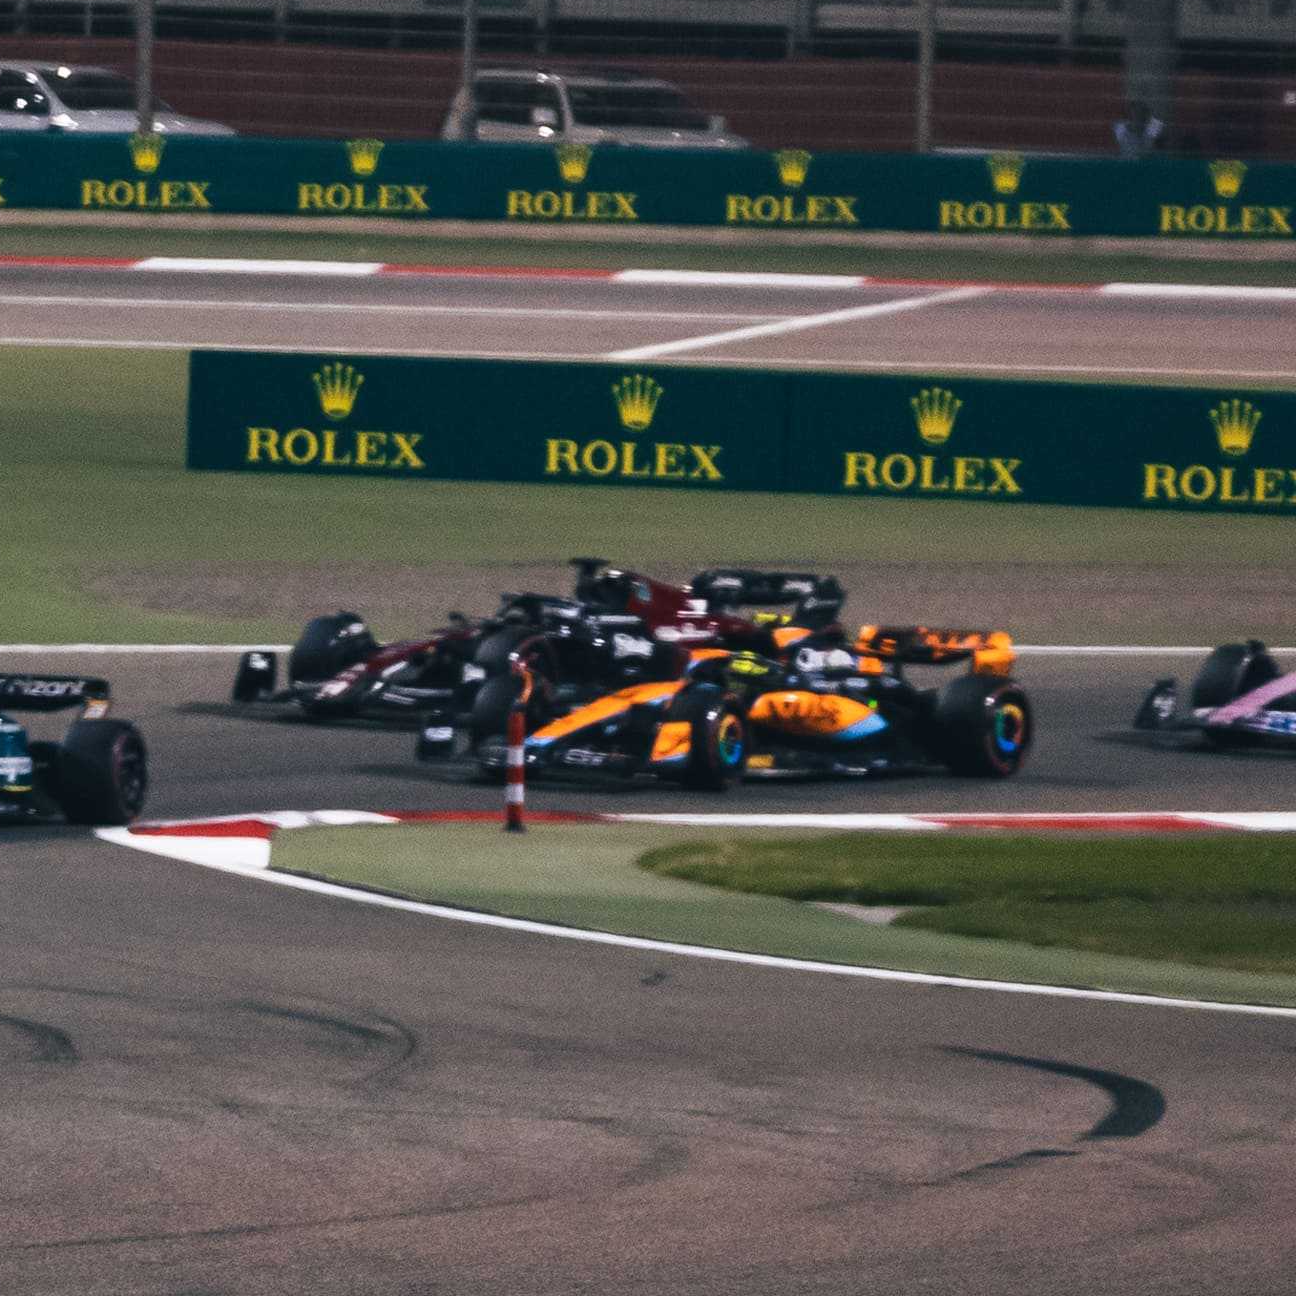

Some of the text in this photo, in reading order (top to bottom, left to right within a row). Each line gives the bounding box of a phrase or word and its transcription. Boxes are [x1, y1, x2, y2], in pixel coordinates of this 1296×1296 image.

[82, 181, 209, 208] ROLEX
[299, 184, 428, 210] ROLEX
[507, 191, 637, 219] ROLEX
[727, 195, 855, 223] ROLEX
[940, 201, 1070, 229] ROLEX
[1161, 206, 1290, 232] ROLEX
[248, 428, 423, 468] ROLEX
[546, 438, 721, 480] ROLEX
[844, 452, 1020, 493] ROLEX
[1144, 464, 1296, 503] ROLE
